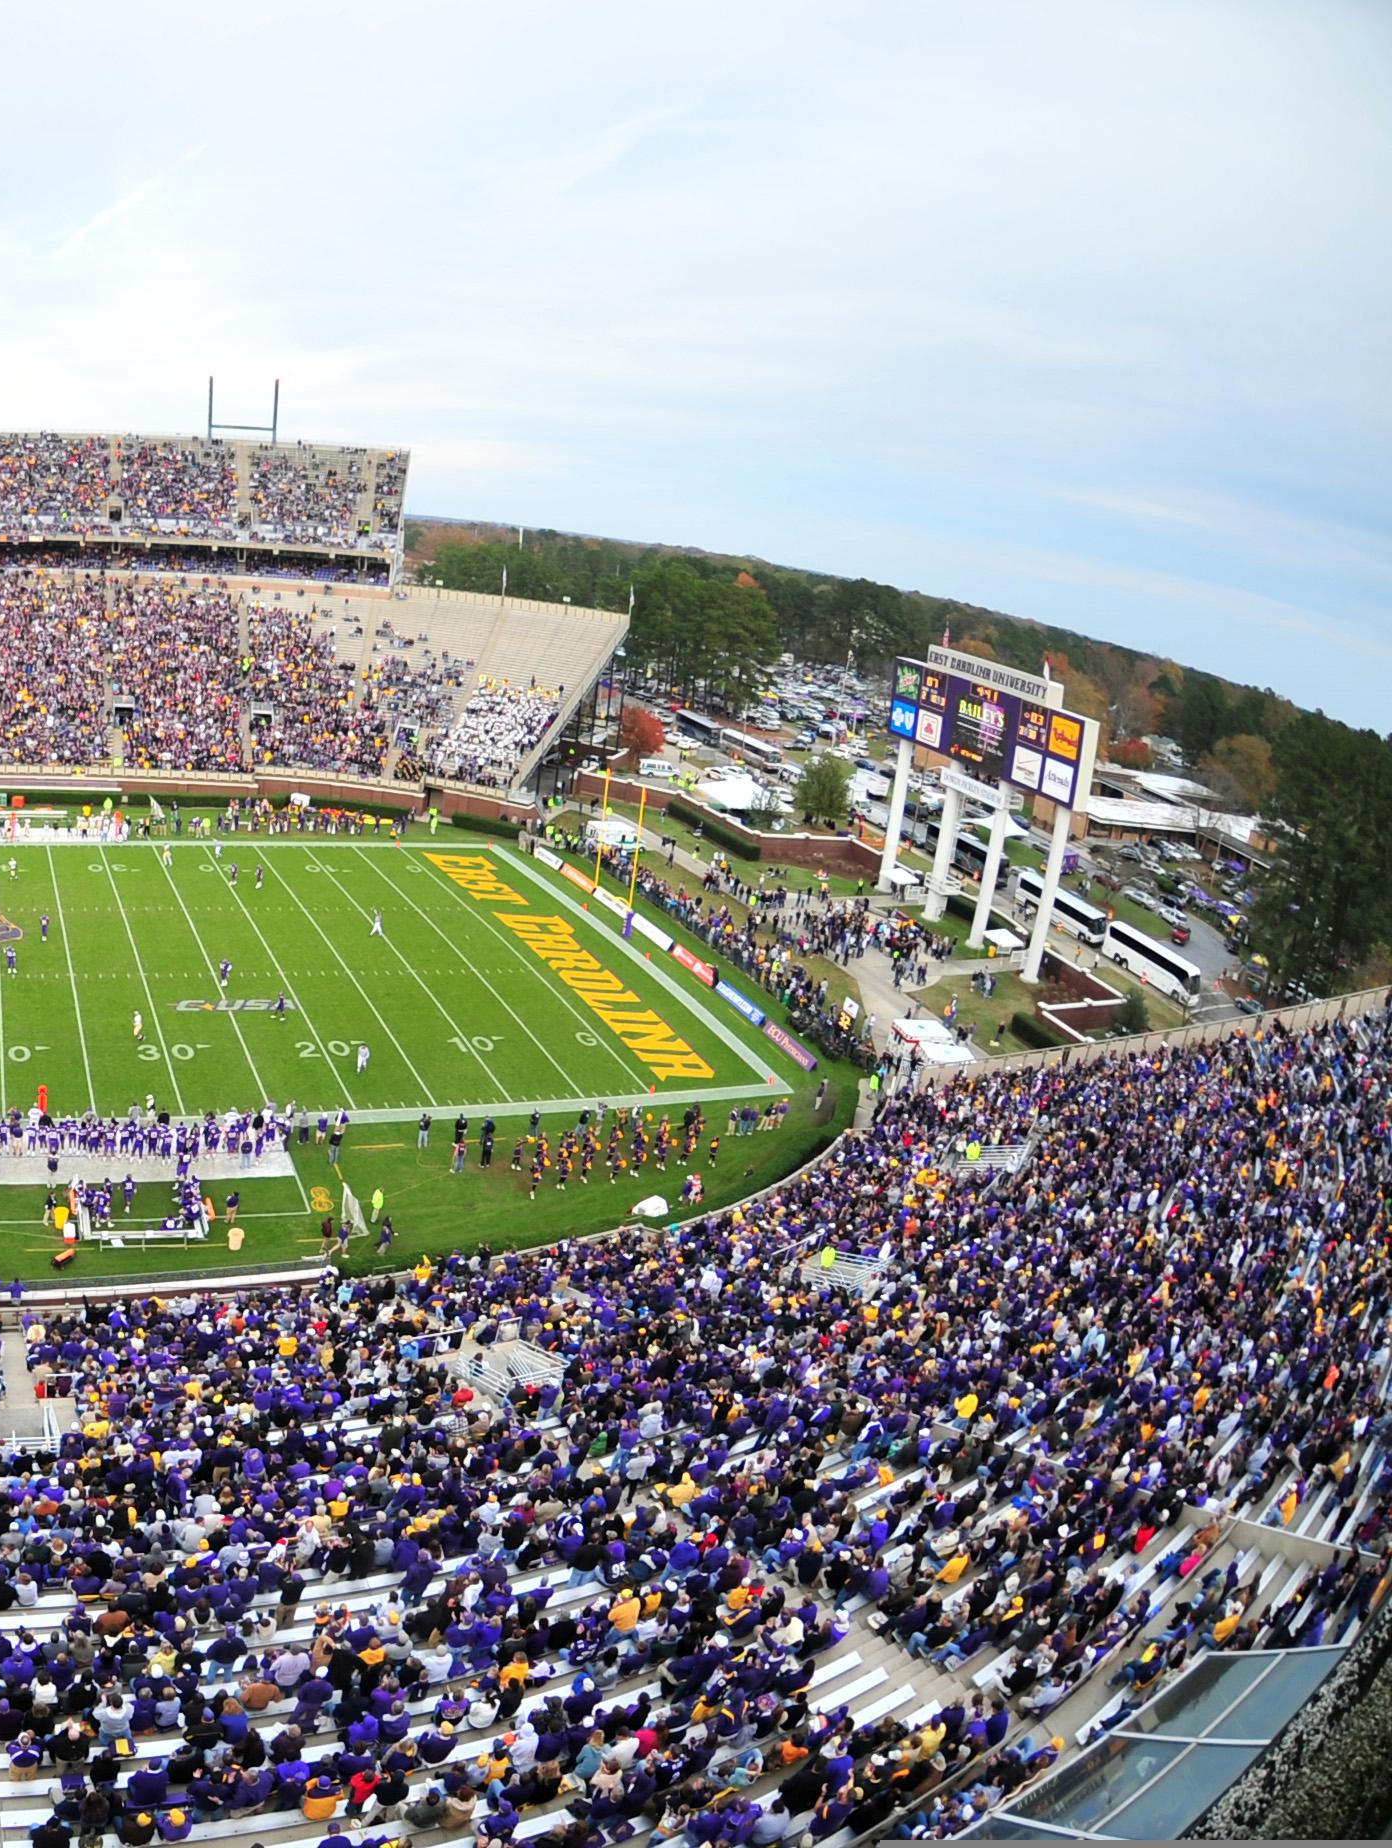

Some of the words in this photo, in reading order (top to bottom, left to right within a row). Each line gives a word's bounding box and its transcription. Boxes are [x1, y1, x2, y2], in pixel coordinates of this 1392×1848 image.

[929, 651, 948, 667] EAST
[951, 658, 991, 679] CAROLINA
[992, 670, 1047, 699] UNIVERSITY
[422, 852, 529, 906] EAST
[493, 912, 715, 1081] CAROLINA
[575, 1031, 597, 1047] G
[767, 1024, 783, 1042] ECU
[137, 1043, 195, 1061] 30
[298, 1040, 351, 1058] 20
[447, 1036, 494, 1053] 10
